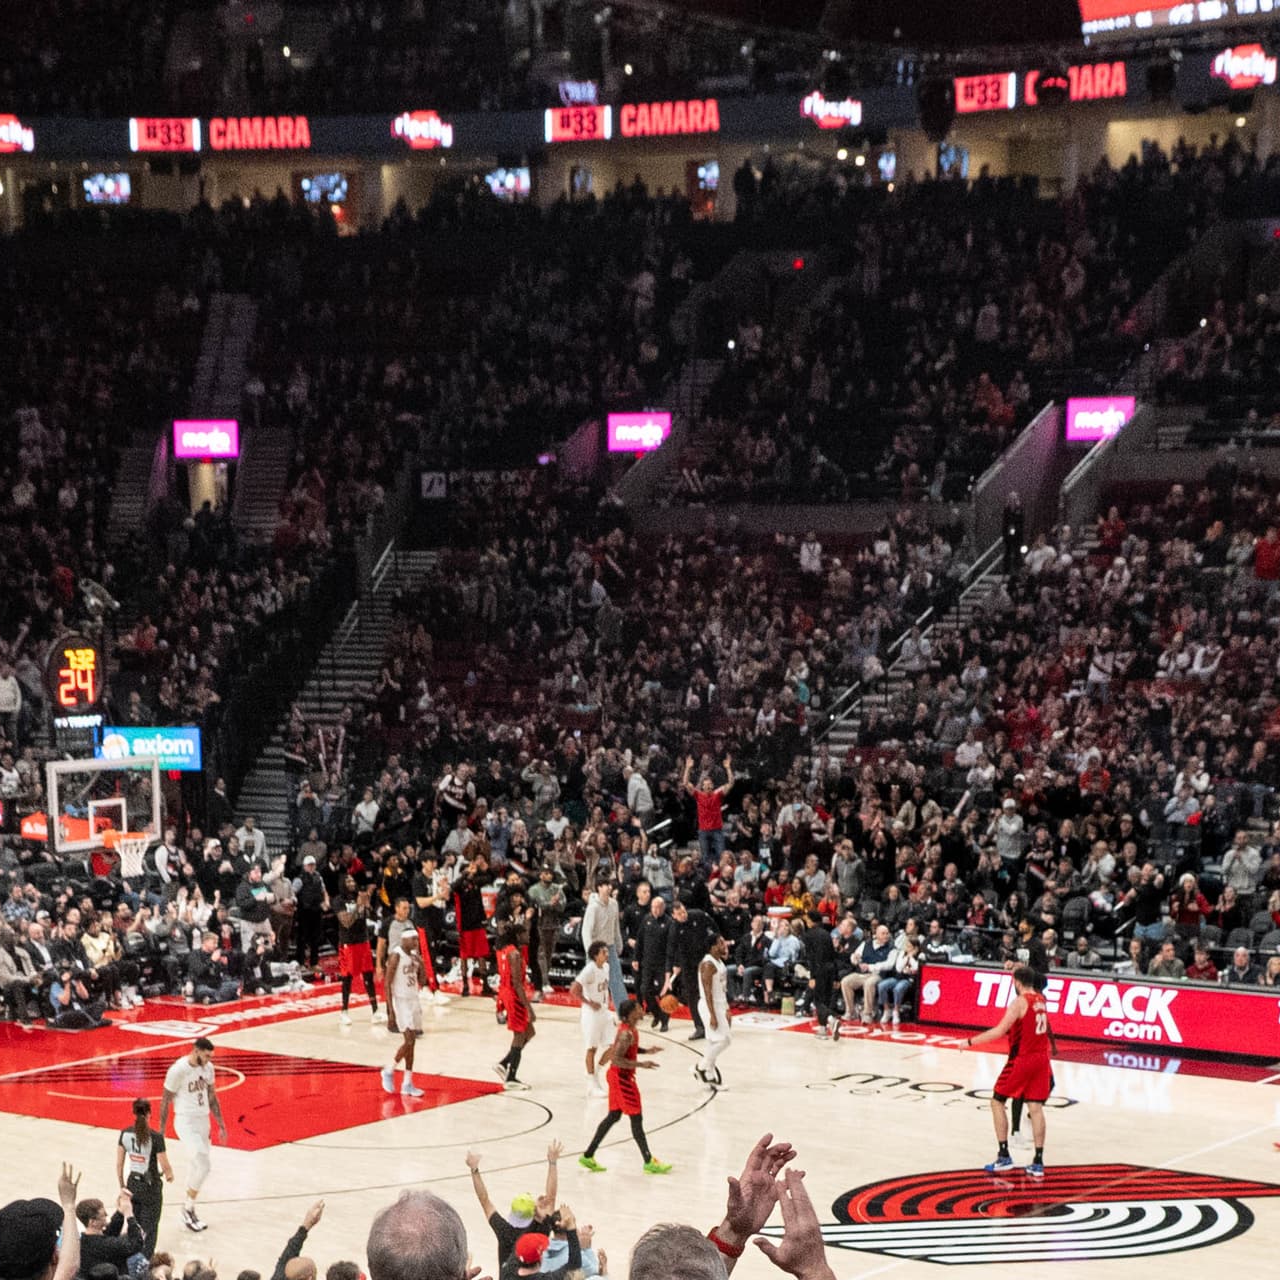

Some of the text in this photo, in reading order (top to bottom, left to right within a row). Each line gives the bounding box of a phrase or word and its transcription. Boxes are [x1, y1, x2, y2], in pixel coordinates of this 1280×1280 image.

[209, 116, 311, 149] CAMARA
[559, 98, 720, 137] #33 CAMARA
[58, 668, 95, 707] 24
[132, 733, 195, 756] axiom
[973, 972, 1184, 1043] TIE RACK
[1103, 1020, 1162, 1041] .com
